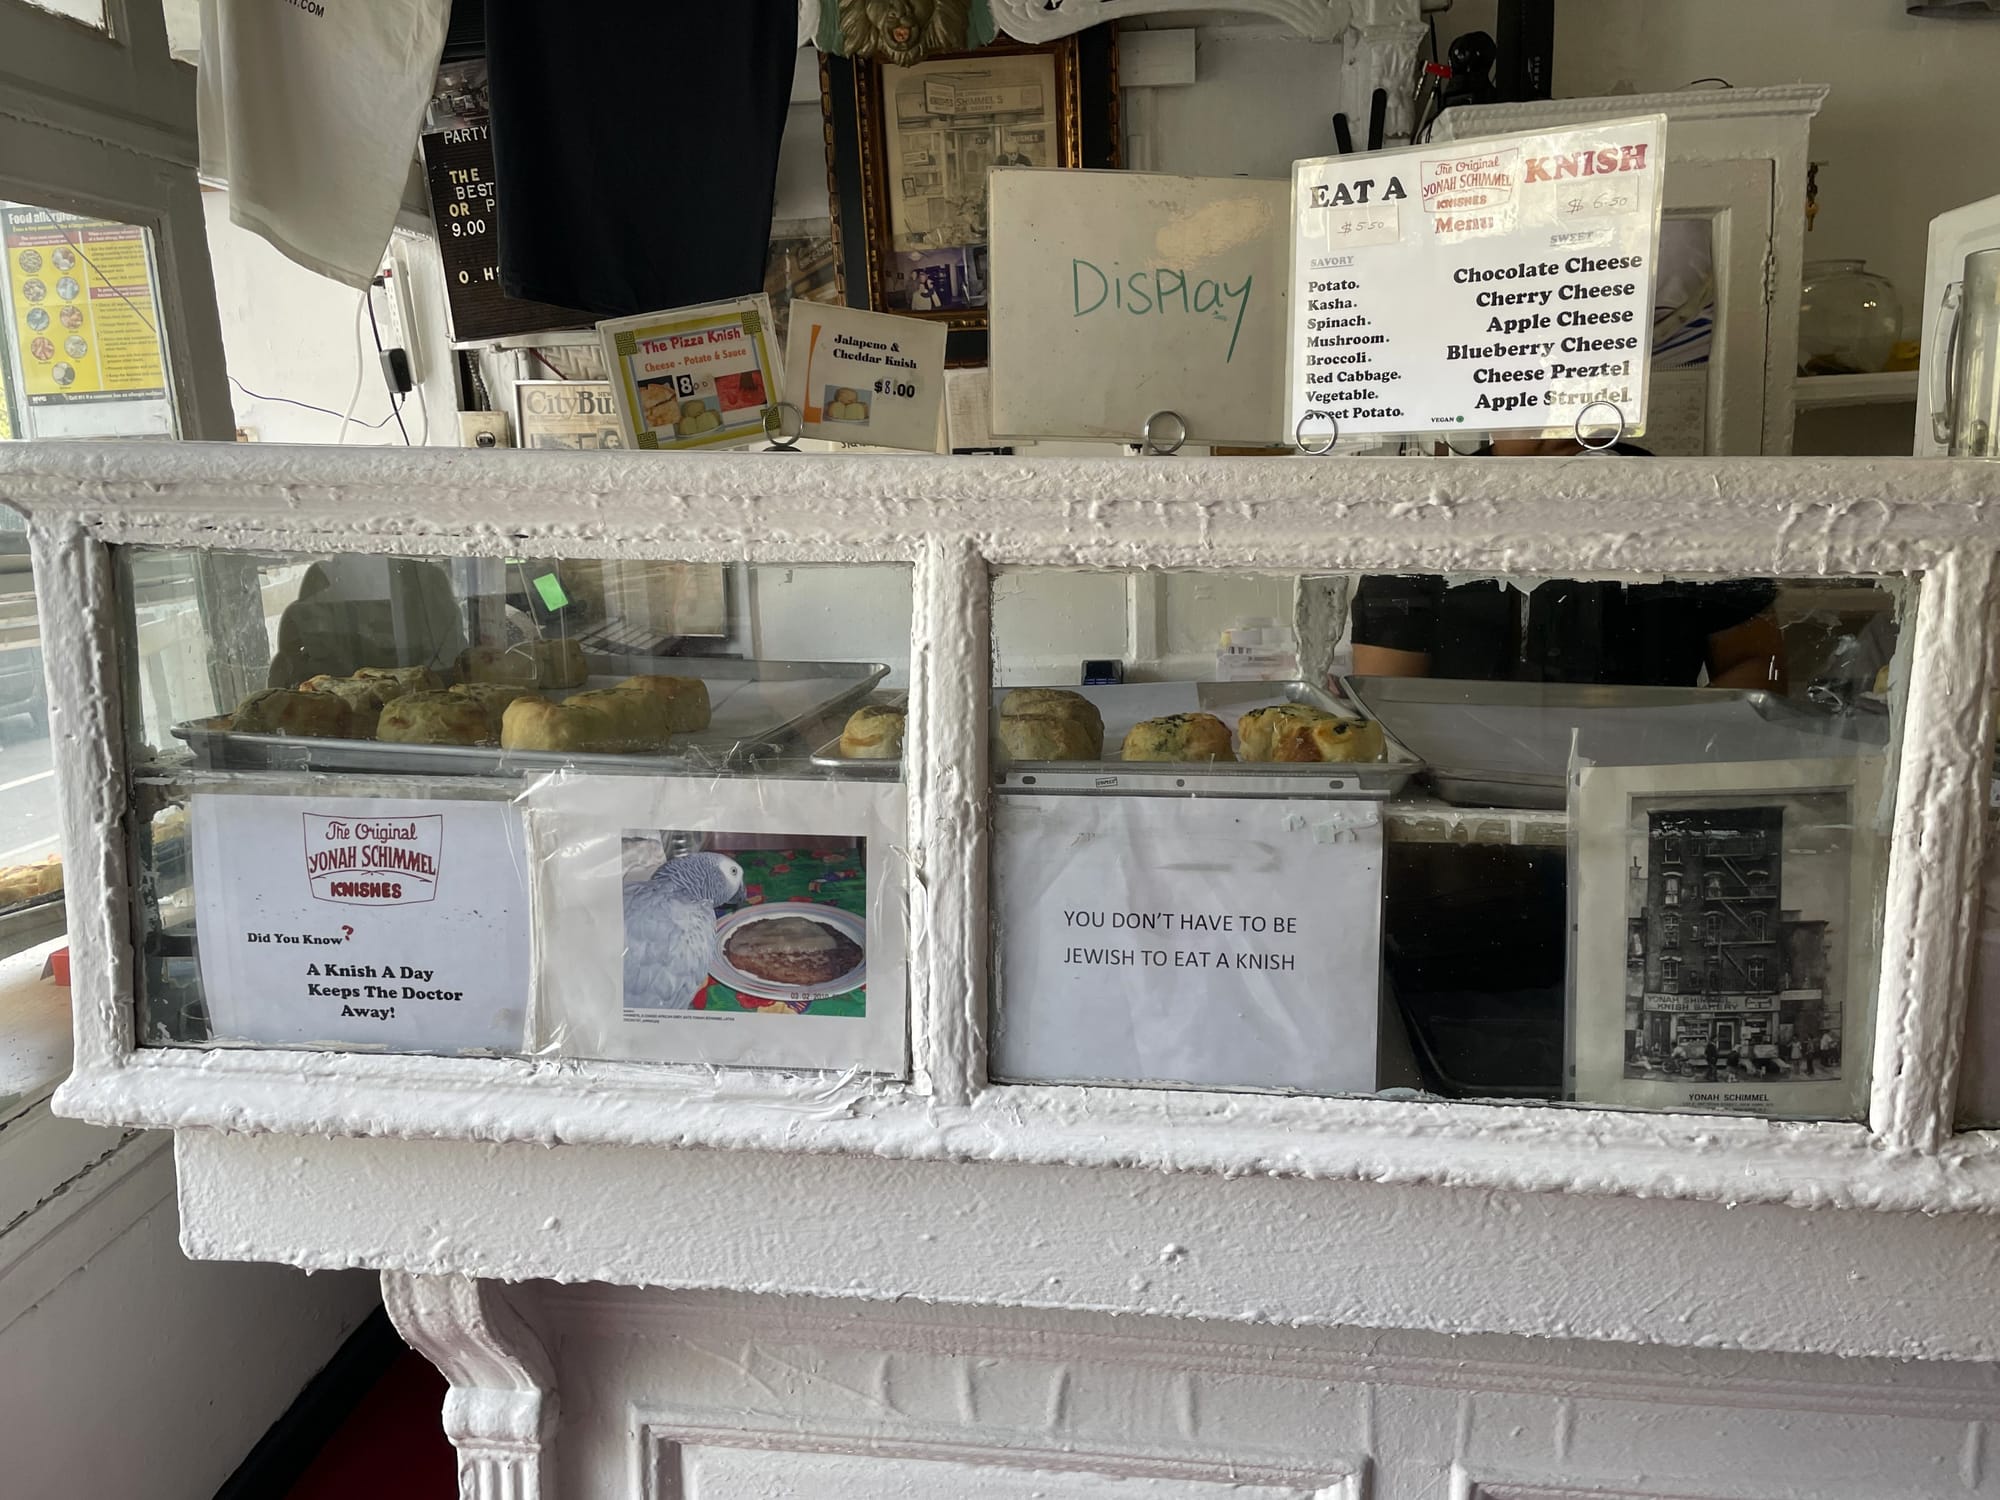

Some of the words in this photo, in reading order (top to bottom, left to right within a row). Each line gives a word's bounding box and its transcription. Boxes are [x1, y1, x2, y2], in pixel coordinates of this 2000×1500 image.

[444, 125, 488, 144] PARTY
[1435, 163, 1453, 176] The
[1455, 156, 1500, 172] Original
[1524, 143, 1648, 183] KNISH
[449, 168, 480, 184] THE
[1423, 176, 1457, 197] YONAH
[1459, 172, 1512, 189] SCHIMMEL
[456, 182, 495, 200] BEST
[1310, 179, 1375, 208] EAT
[1382, 176, 1407, 200] A
[449, 202, 470, 217] OR
[1436, 195, 1487, 210] KNISHES
[8, 211, 33, 225] Food
[1435, 216, 1494, 234] Menu
[452, 219, 486, 237] 9.00
[1550, 231, 1594, 245] SWEET
[1310, 256, 1354, 269] SAVORY
[1453, 262, 1559, 284] Chocolate
[1565, 255, 1642, 274] Cheese
[1308, 279, 1360, 293] Potato.
[1476, 289, 1553, 307] Cherry
[1558, 283, 1635, 301] Cheese
[1308, 298, 1357, 312] Kasha.
[1307, 315, 1371, 331] Spinach.
[1486, 313, 1551, 334] Apple
[1556, 310, 1634, 327] Cheese
[642, 340, 668, 355] The
[670, 335, 704, 350] Pizza
[706, 328, 741, 343] Knish
[834, 334, 888, 351] Jalapeno
[890, 342, 900, 353] &
[1307, 334, 1390, 348] Mushroom.
[1447, 341, 1555, 360] Blueberry
[1560, 337, 1638, 353] Cheese
[645, 360, 675, 373] Cheese
[684, 355, 712, 366] Potato
[714, 352, 721, 361] &
[723, 348, 747, 358] Sauce
[833, 348, 882, 364] Cheddar
[885, 356, 917, 369] Knish
[1306, 352, 1372, 366] Broccoli.
[1306, 372, 1333, 385] Red
[1336, 370, 1402, 383] Cabbage.
[1473, 368, 1545, 384] Cheese
[1550, 360, 1630, 379] Preztel
[874, 380, 915, 398] $8.00
[1305, 389, 1379, 404] Vegetable.
[527, 391, 616, 419] CityBu
[1474, 392, 1538, 411] Apple
[1543, 387, 1632, 406] Strudel.
[1353, 407, 1404, 419] Potato.
[325, 820, 350, 840] The
[355, 822, 418, 843] Original
[308, 846, 357, 874] YONAH
[361, 845, 436, 876] SCHIMMEL
[330, 882, 402, 899] KNISHES
[1063, 910, 1105, 928] YOU
[1112, 912, 1175, 930] DON'T
[1180, 914, 1233, 931] HAVE
[1239, 915, 1267, 933] TO
[1273, 917, 1297, 934] BE
[247, 932, 271, 944] Did
[274, 933, 300, 945] You
[1063, 947, 1134, 966] JEWISH
[1140, 950, 1168, 967] TO
[1174, 950, 1211, 968] EAT
[1216, 952, 1230, 969] A
[1236, 953, 1295, 971] KNISH
[306, 963, 321, 976] A
[324, 963, 377, 979] Knish
[381, 966, 396, 979] A
[400, 966, 434, 982] Day
[308, 983, 360, 1000] Keeps
[364, 985, 398, 999] The
[402, 986, 464, 1001] Doctor
[340, 1004, 396, 1021] Away!
[1688, 1093, 1720, 1101] YONAH
[1723, 1093, 1769, 1102] SCHIMMEL
